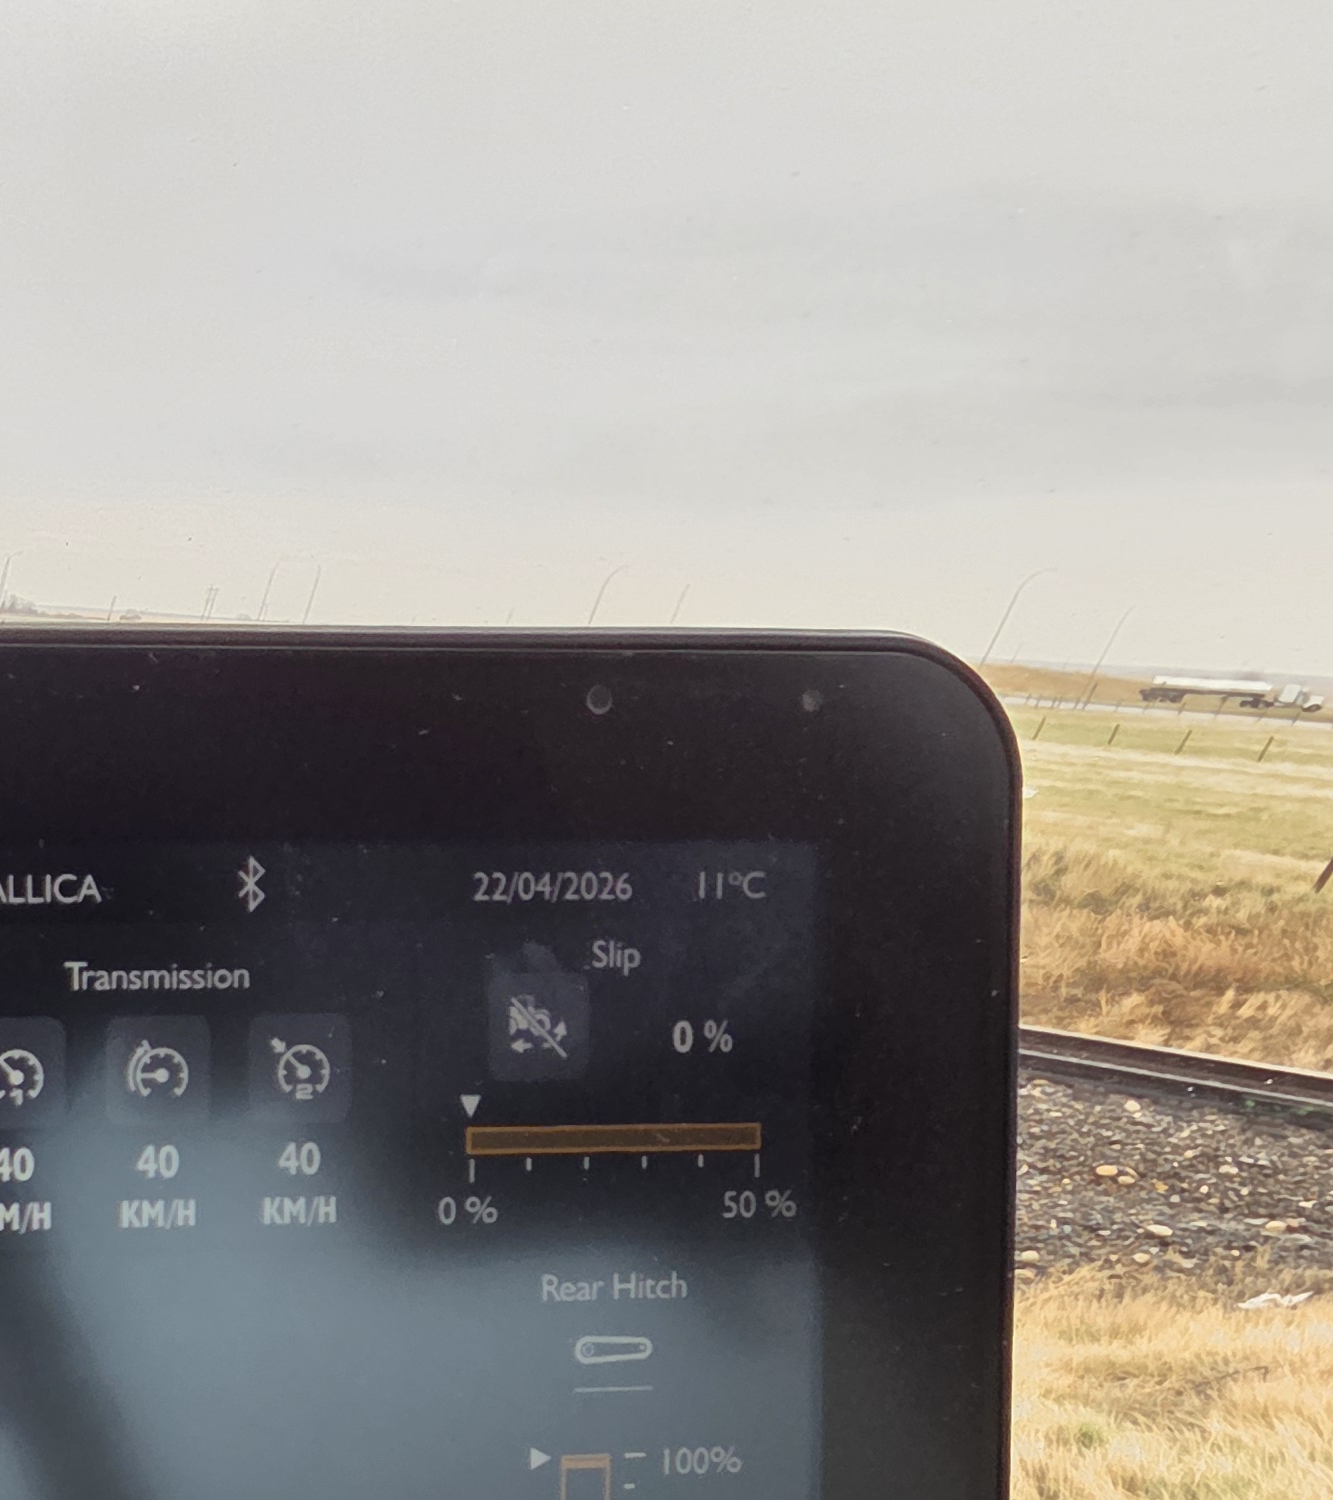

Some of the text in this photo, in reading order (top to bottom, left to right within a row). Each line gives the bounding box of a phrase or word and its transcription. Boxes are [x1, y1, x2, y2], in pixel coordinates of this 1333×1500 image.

[473, 871, 632, 904] 22/04/2026
[591, 940, 641, 976] Slip
[65, 961, 250, 992] Transmission
[673, 1020, 733, 1054] 0 %
[137, 1144, 180, 1179] 40
[278, 1141, 321, 1176] 40
[120, 1199, 196, 1229] KM/H
[263, 1196, 338, 1225] KM/H
[438, 1196, 498, 1226] 0 %
[722, 1189, 797, 1220] 50 %
[541, 1271, 688, 1302] Rear Hitch
[661, 1446, 742, 1475] 100%
